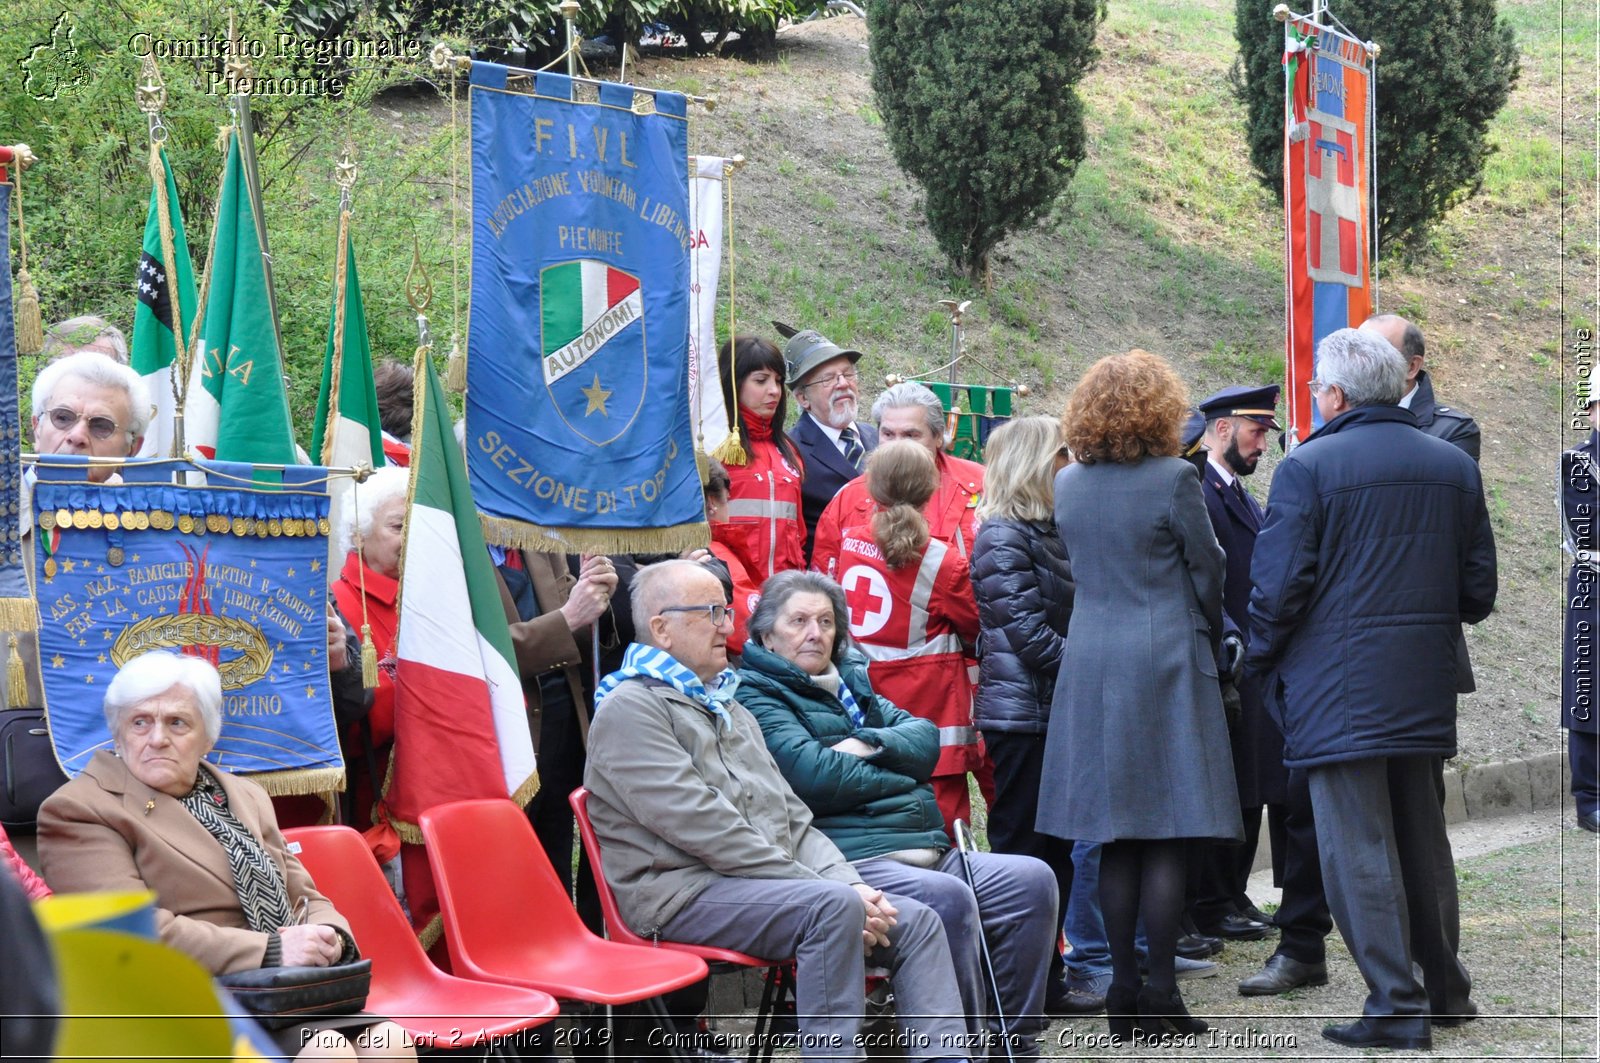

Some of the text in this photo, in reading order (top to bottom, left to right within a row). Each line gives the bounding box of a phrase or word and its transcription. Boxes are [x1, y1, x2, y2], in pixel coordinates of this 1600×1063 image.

[548, 301, 636, 377] AUTONOMI
[478, 431, 678, 514] SEZIONE DI TORO
[857, 540, 878, 558] ROSSA
[50, 561, 316, 623] ASS. NAZ. FAMIGLIE MARTIRI E CADUTI
[64, 584, 303, 640] PER LA CAUSA DI LIBERAZIONE
[128, 623, 257, 649] ONORE E GLORIA
[221, 694, 282, 717] TORINO
